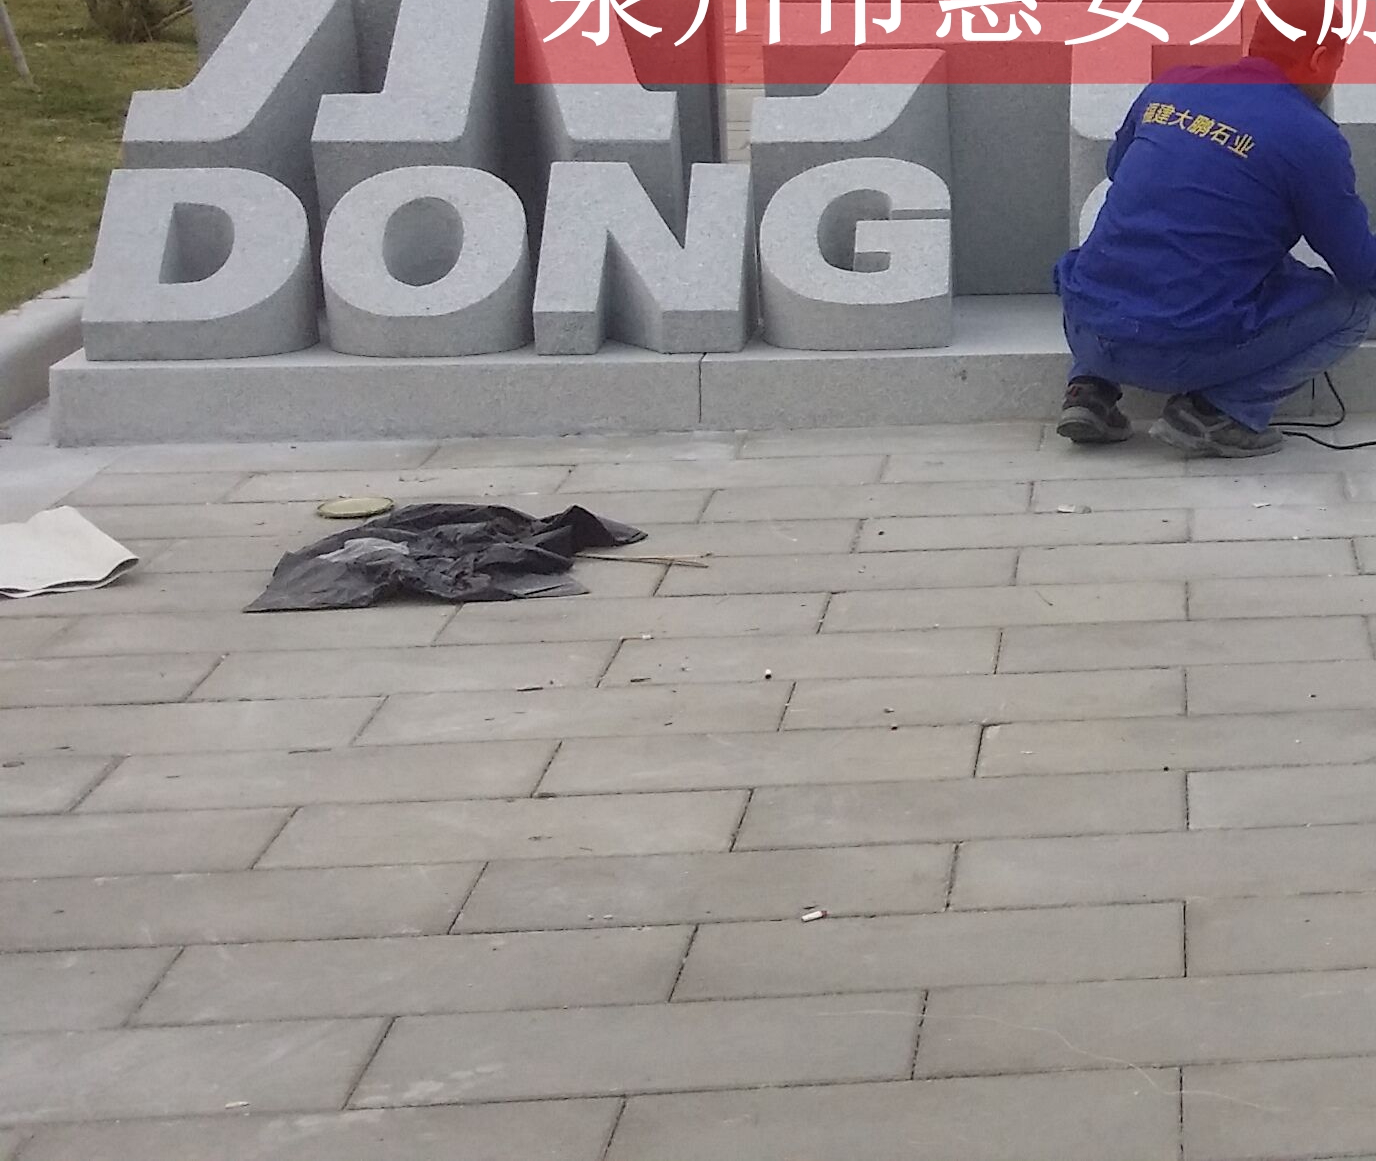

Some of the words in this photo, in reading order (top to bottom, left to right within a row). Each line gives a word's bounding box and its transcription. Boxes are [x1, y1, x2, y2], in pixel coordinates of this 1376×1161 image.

[1141, 101, 1255, 159] 福建大鹏石业
[82, 156, 955, 360] DONG
